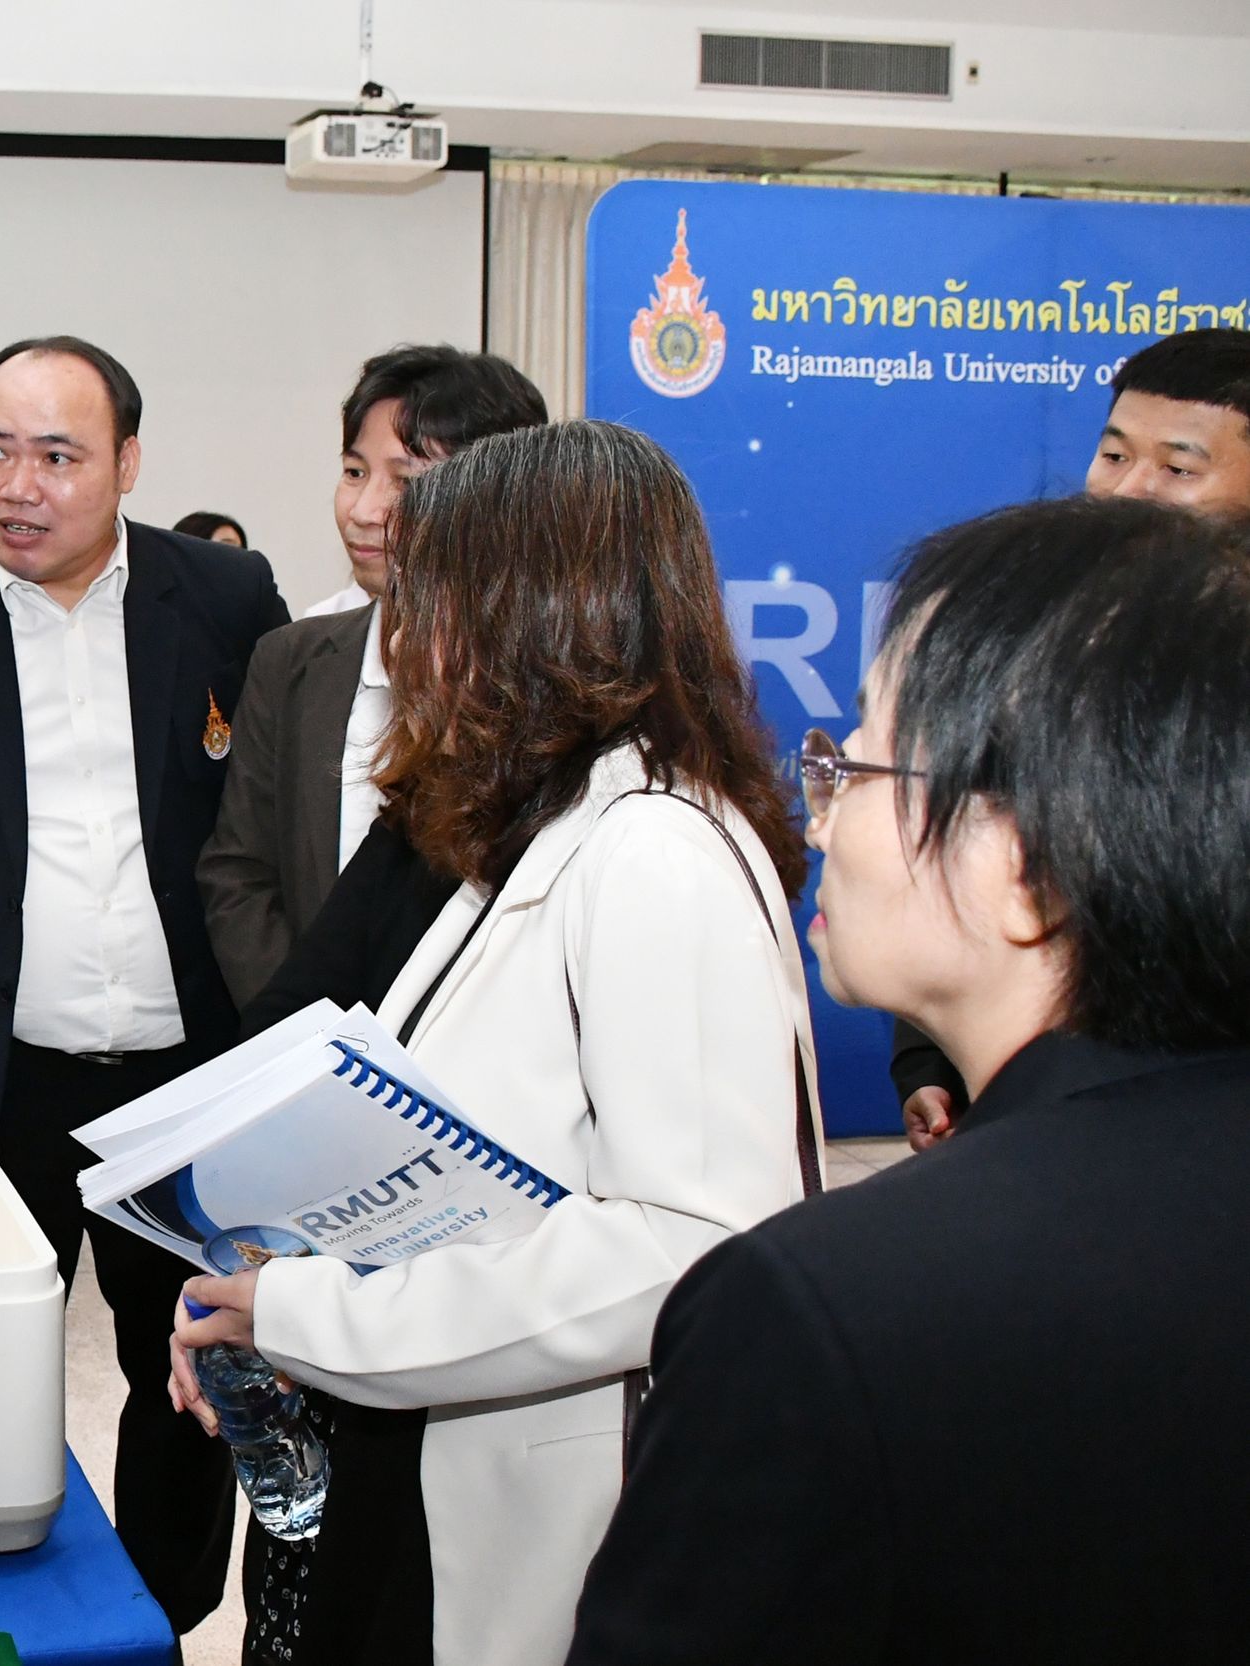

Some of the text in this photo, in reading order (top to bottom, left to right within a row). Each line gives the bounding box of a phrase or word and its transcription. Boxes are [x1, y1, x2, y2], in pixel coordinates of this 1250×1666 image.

[752, 277, 1250, 335] มหาวิทยาลัยเทคโนโลยีราช
[751, 345, 934, 386] Rajamangala
[944, 352, 1086, 391] University
[292, 1148, 444, 1238] RMUTT
[323, 1197, 423, 1247] Moving Towards
[384, 1205, 489, 1261] University
